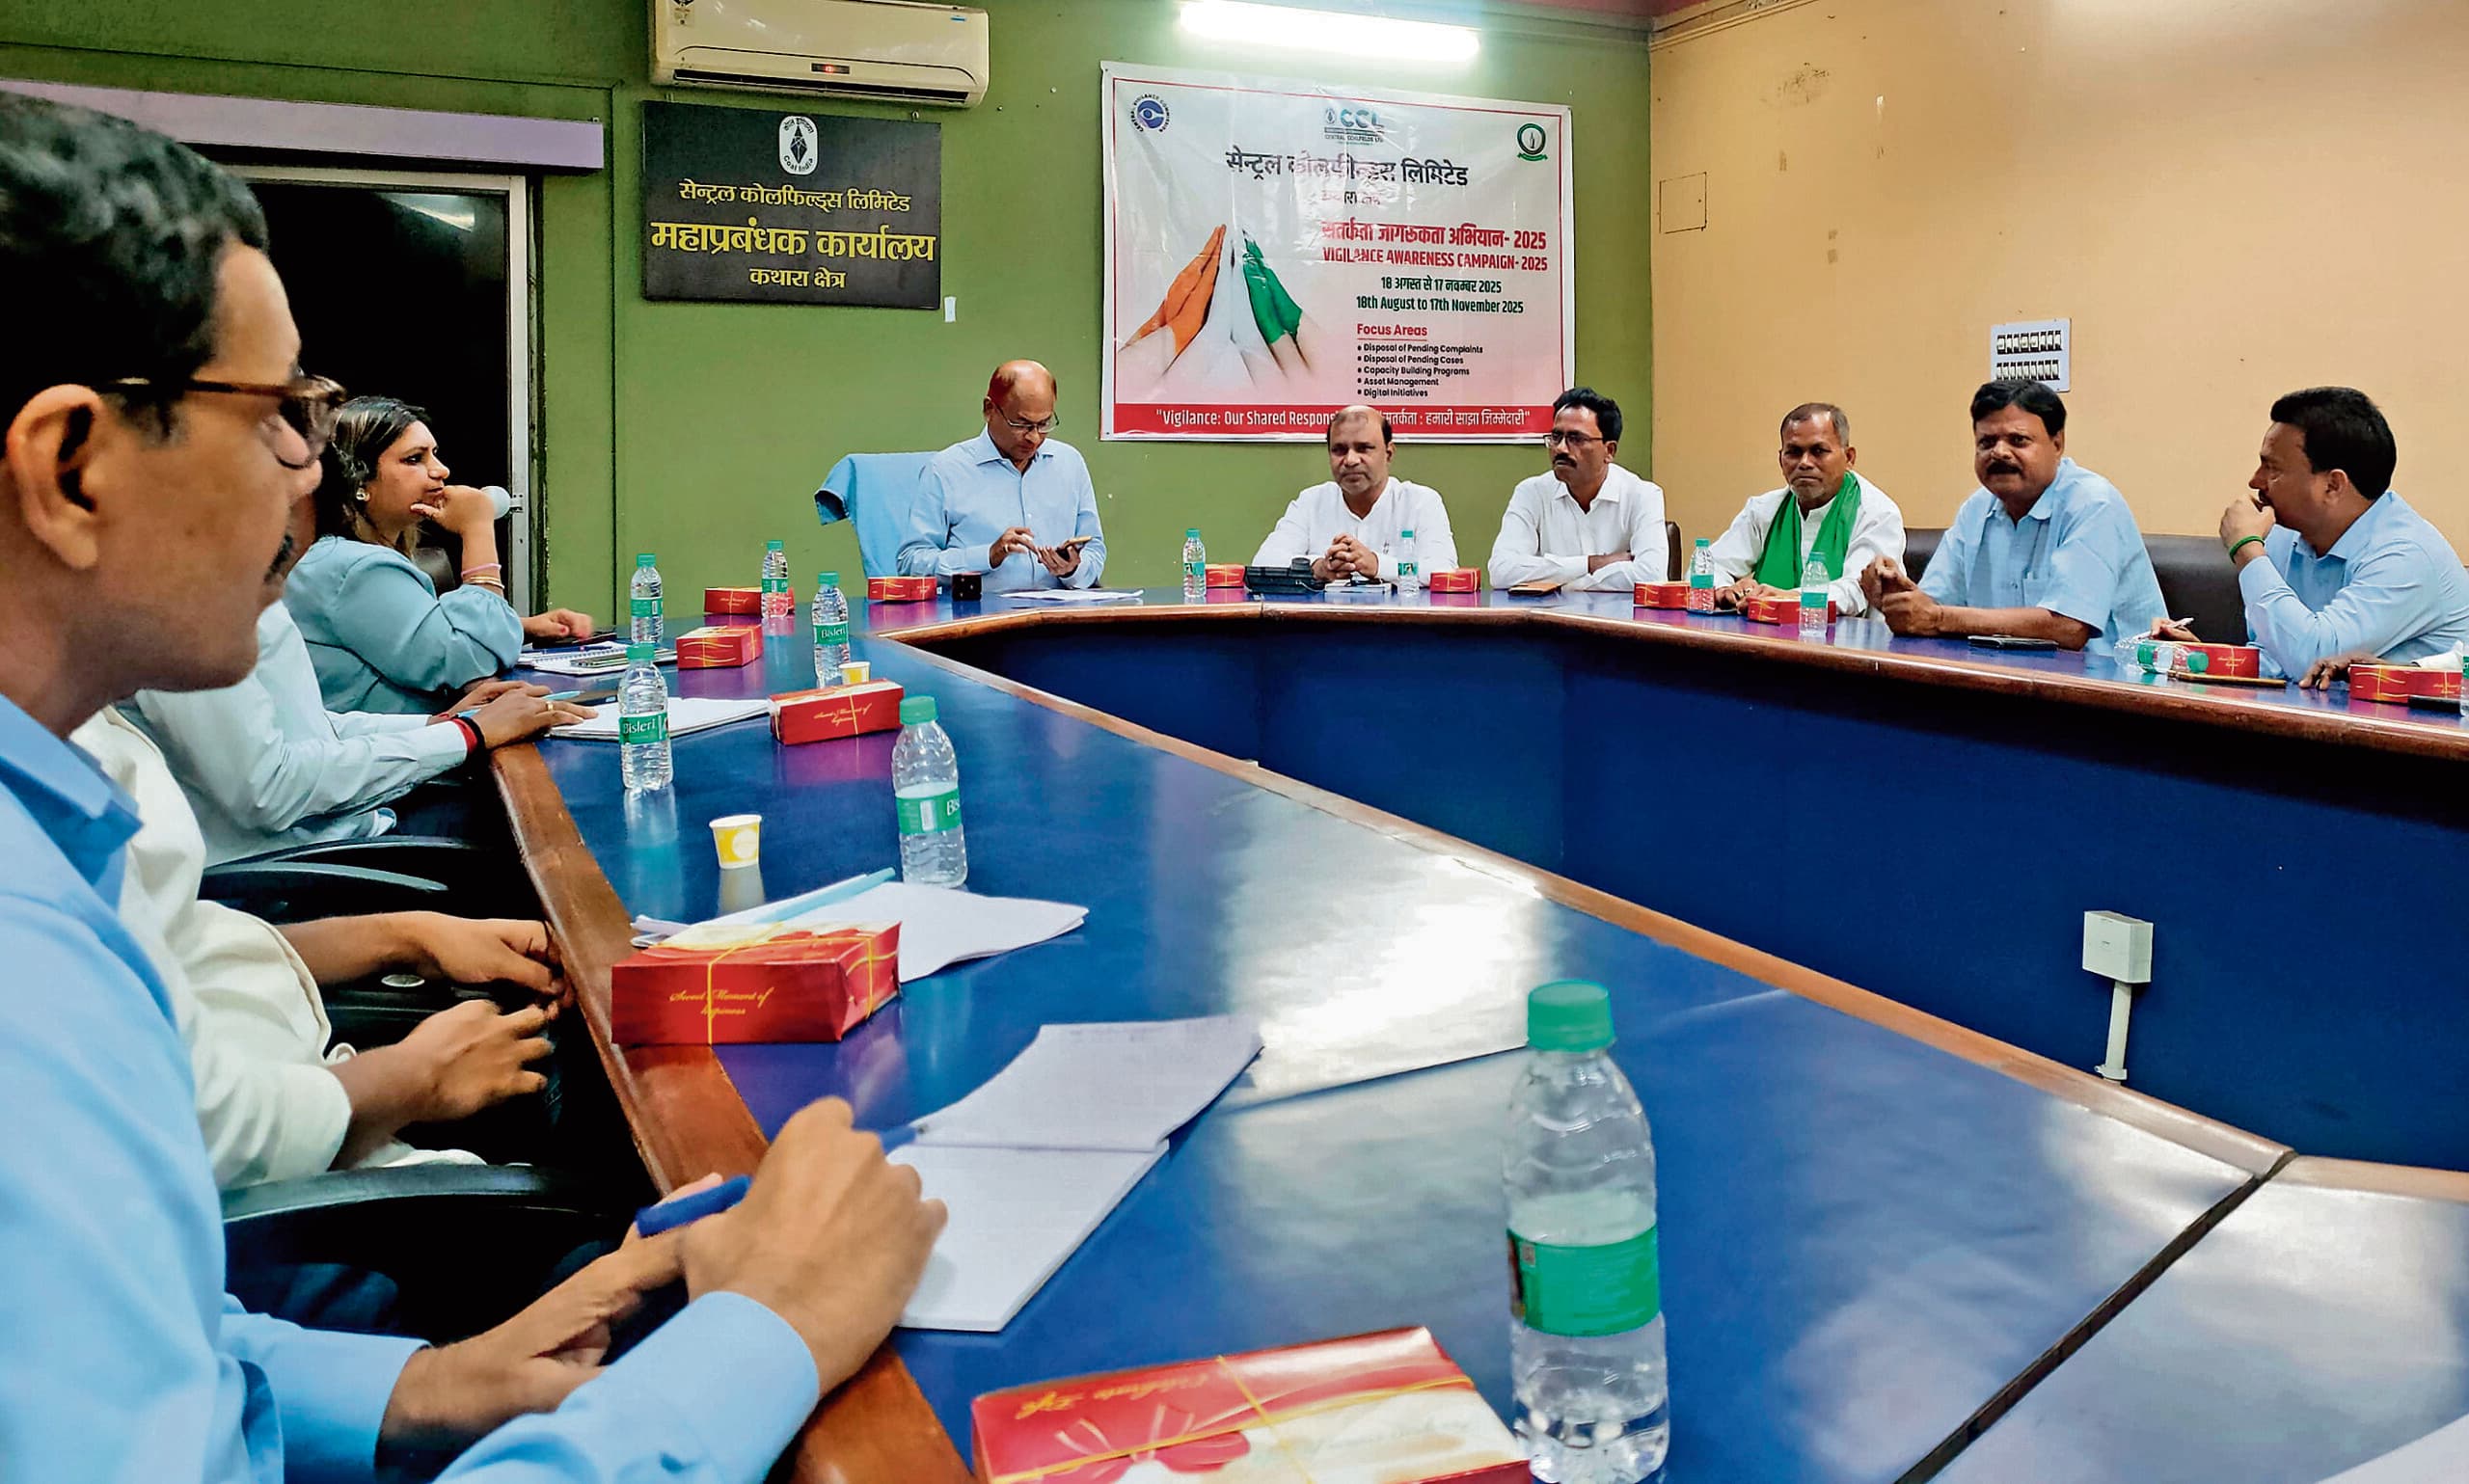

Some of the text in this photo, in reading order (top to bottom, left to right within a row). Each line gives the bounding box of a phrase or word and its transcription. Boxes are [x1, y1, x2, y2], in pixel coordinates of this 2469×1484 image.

[1341, 109, 1385, 128] CCL
[783, 155, 798, 172] Coal
[1226, 146, 1283, 180] सेन्ट्रल
[1400, 157, 1469, 186] लिमिटेड
[679, 178, 911, 213] सेन्ट्रल कोलफिल्ड्स लिमिटेड
[650, 217, 936, 261] महाप्रबंधक कार्यालय
[1377, 223, 1446, 245] जागरूकता
[1513, 230, 1547, 250] 2025
[1322, 247, 1548, 271] VIGILANCE AWARENESS CAMPAIGN- 2025
[749, 266, 846, 288] कथारा क्षेत्र
[1381, 274, 1502, 293] 18 अगस्त से 17 नवम्बर 2025
[1356, 295, 1524, 313] 18th August to 17th November 2025
[1357, 323, 1427, 337] Focus Areas
[1364, 343, 1483, 355] Disposal of Pending Complaints
[1364, 354, 1464, 365] Disposal of Pending Cases
[1364, 365, 1470, 377] Capacity Building Programs
[1364, 377, 1439, 388] Asset Management
[1364, 388, 1428, 398] Digital Initiatives
[1156, 409, 1221, 427] "Vigilance:
[1224, 411, 1244, 425] Our
[1246, 411, 1286, 425] Shared
[1425, 409, 1453, 425] हमारी
[1455, 412, 1479, 426] साझा
